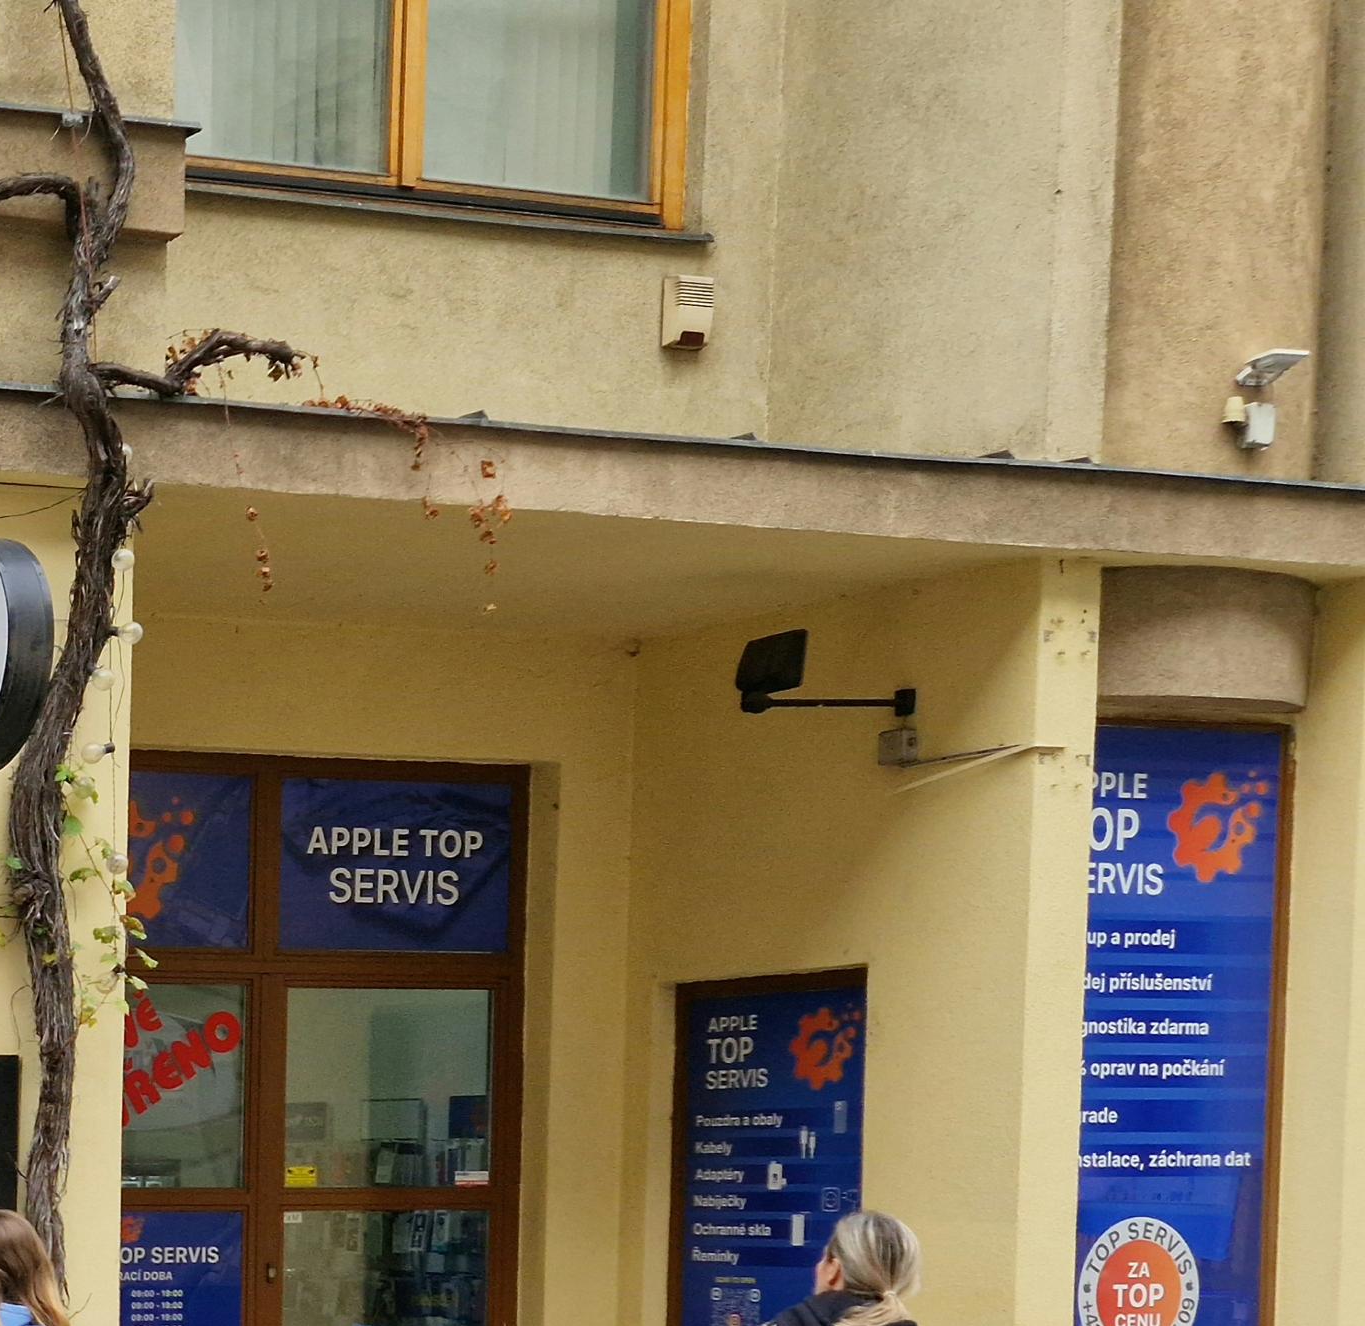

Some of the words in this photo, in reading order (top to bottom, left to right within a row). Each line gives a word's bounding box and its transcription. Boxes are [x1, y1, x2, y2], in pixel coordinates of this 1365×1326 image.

[306, 826, 410, 857] APPLE
[420, 829, 484, 858] TOP
[329, 867, 460, 906] SERVIS
[1111, 932, 1120, 945] a
[1124, 929, 1176, 949] prodej
[1109, 973, 1214, 993] příslušenství
[708, 1015, 758, 1033] APPLE
[1150, 1019, 1209, 1037] zdarma
[707, 1037, 755, 1064] TOP
[705, 1068, 769, 1090] SERVIS
[1091, 1062, 1136, 1080] oprav
[1140, 1062, 1159, 1076] na
[1162, 1059, 1225, 1080] počkání
[696, 1115, 740, 1127] Pouzdra
[751, 1113, 783, 1129] obaly
[695, 1141, 733, 1156] Kabely
[1149, 1149, 1222, 1168] záchrana
[1225, 1151, 1252, 1168] dat
[693, 1223, 746, 1237] Ochranné
[748, 1224, 771, 1237] skla
[151, 1246, 220, 1264] SERVIS
[1086, 1230, 1120, 1274] TOP
[1128, 1222, 1193, 1276] SERVIS
[143, 1271, 174, 1281] DOBA
[1127, 1262, 1151, 1278] ZA
[1113, 1283, 1165, 1309] TOP
[1177, 1297, 1195, 1324] 09
